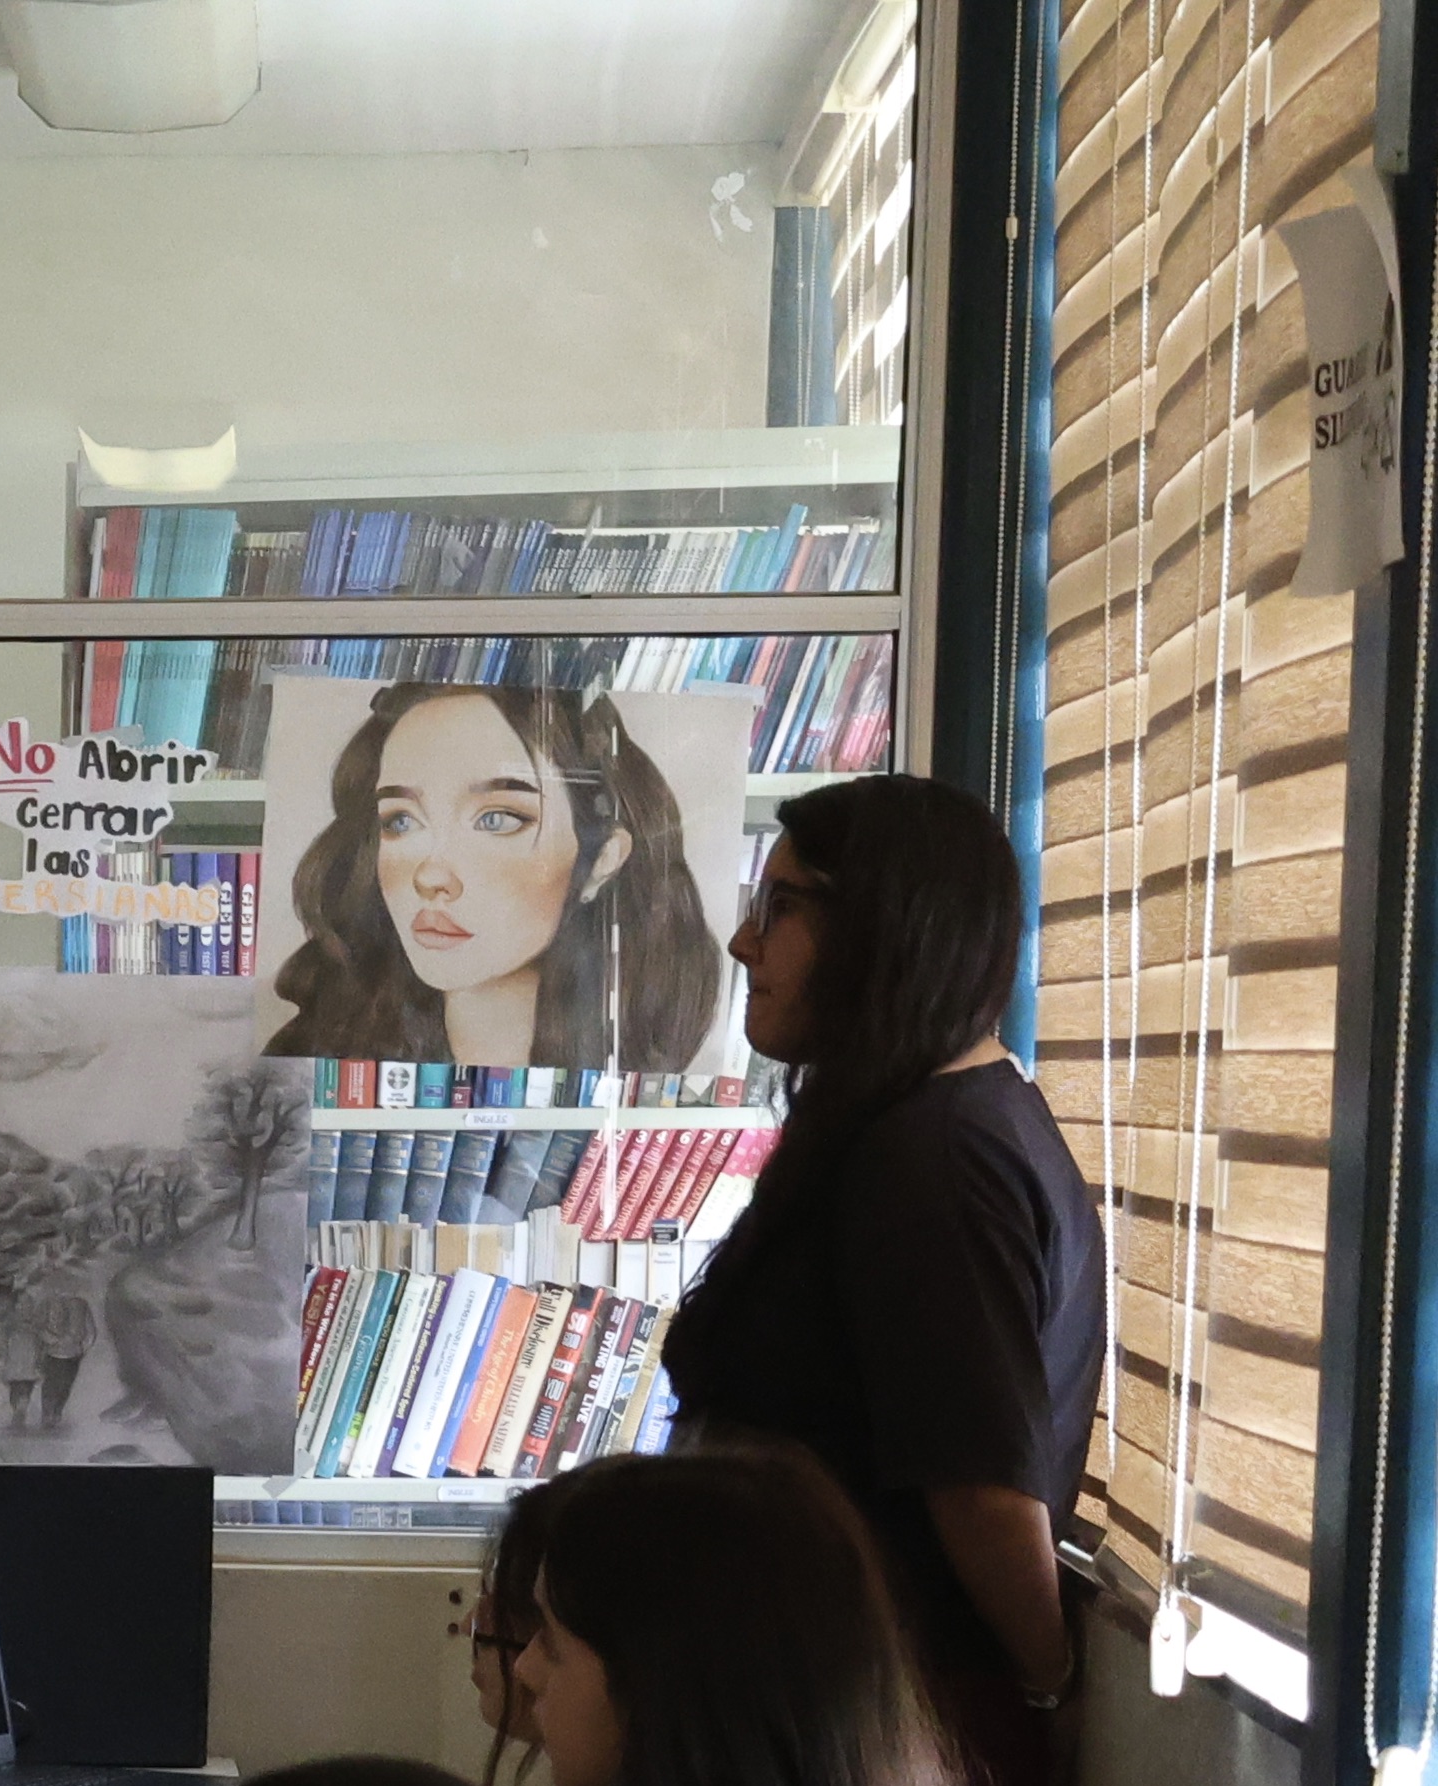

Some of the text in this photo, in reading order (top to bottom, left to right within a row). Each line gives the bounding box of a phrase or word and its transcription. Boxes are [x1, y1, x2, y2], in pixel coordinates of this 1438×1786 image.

[79, 740, 207, 783] Abrir
[27, 838, 89, 878] las
[634, 1130, 649, 1144] 3
[655, 1131, 669, 1144] 4
[679, 1131, 693, 1145] 6
[699, 1133, 715, 1145] 7
[719, 1132, 734, 1147] 8
[576, 1330, 616, 1424] DYING TO LIVE
